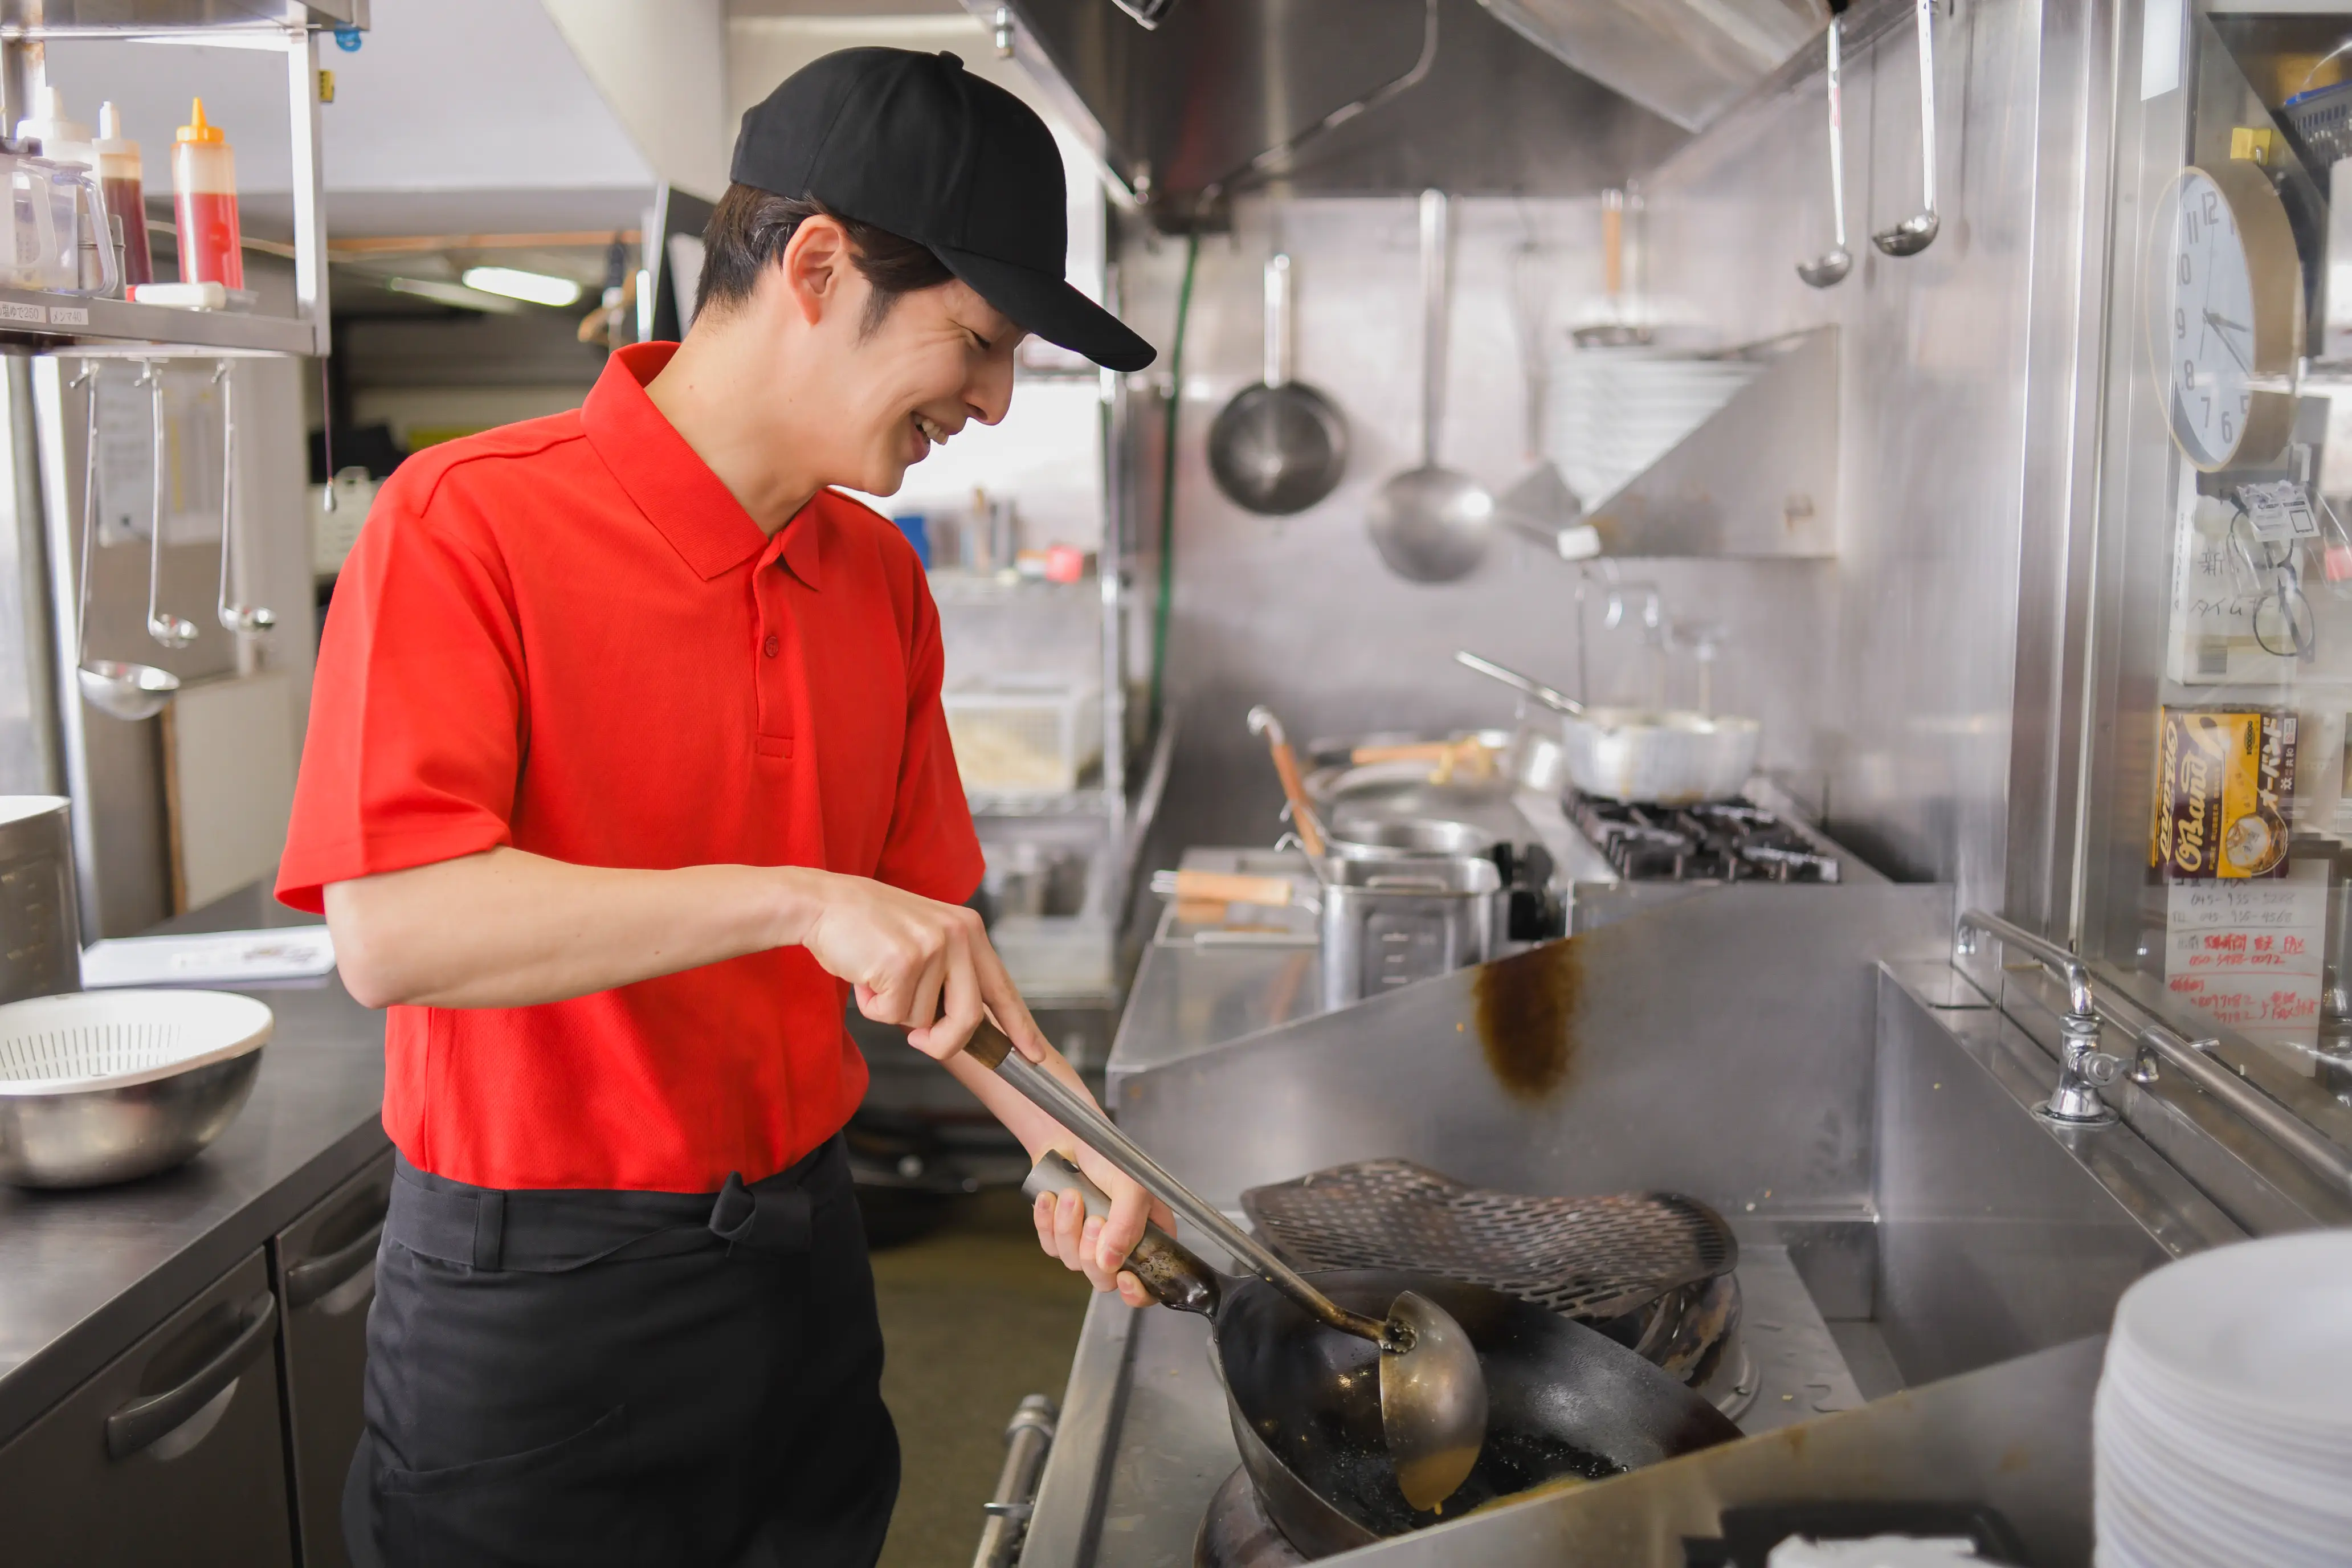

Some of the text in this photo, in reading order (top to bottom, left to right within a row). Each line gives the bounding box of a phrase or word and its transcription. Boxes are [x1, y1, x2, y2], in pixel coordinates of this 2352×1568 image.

[2202, 191, 2219, 226] 12
[2187, 211, 2198, 244] 11
[2177, 308, 2186, 339] 9
[2184, 360, 2194, 391] 8
[2201, 397, 2211, 428] 7
[2222, 411, 2232, 444] 6
[2260, 717, 2282, 812] オーバンド
